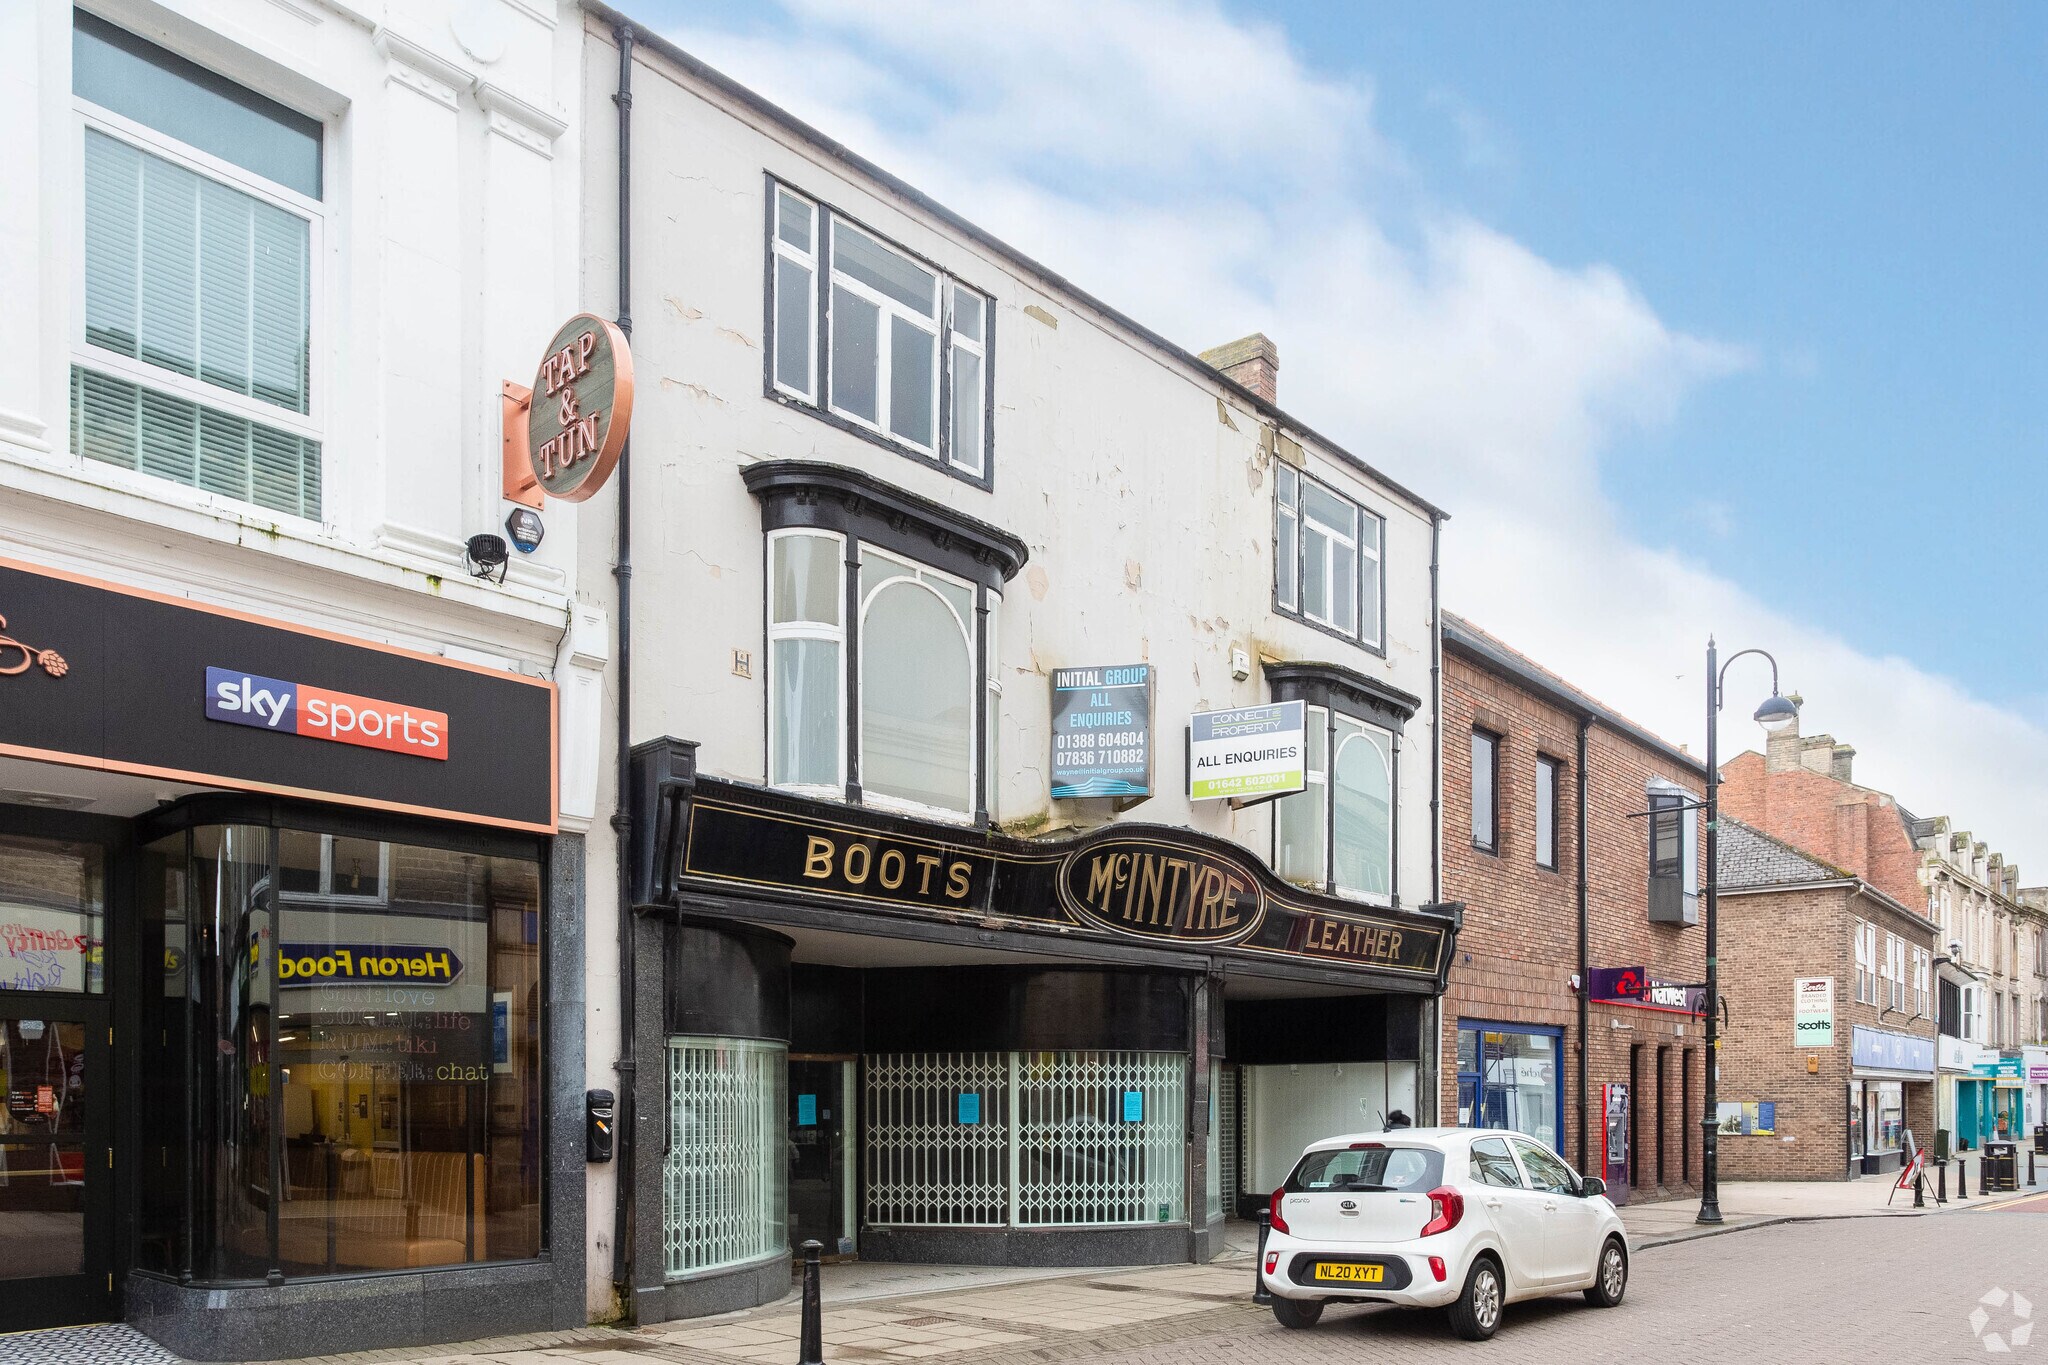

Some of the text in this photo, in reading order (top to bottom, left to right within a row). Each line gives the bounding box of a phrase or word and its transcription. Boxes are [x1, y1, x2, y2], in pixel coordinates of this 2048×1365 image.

[542, 331, 596, 397] TAP
[558, 386, 579, 428] &
[540, 409, 600, 480] TUN
[1057, 667, 1147, 687] INITIAL GROUP
[1090, 693, 1111, 707] ALL
[216, 676, 440, 748] sky sports
[1070, 711, 1132, 728] ENQUIRIES
[1212, 709, 1272, 724] CONNECT
[1212, 721, 1280, 737] PROPERTY
[1057, 731, 1144, 749] 01388 604604
[1057, 749, 1144, 766] 07836 710882
[1197, 746, 1297, 768] ALL ENQUIRIES
[1056, 766, 1145, 776] wayne@initialgroup.co.uk
[1208, 773, 1286, 790] 01642 602001
[803, 835, 972, 899] BOOTS
[1305, 918, 1402, 960] LEATHER
[1651, 980, 1687, 1007] NatWest
[1797, 1020, 1831, 1030] scotts
[1320, 1265, 1378, 1280] NL20 XYT
